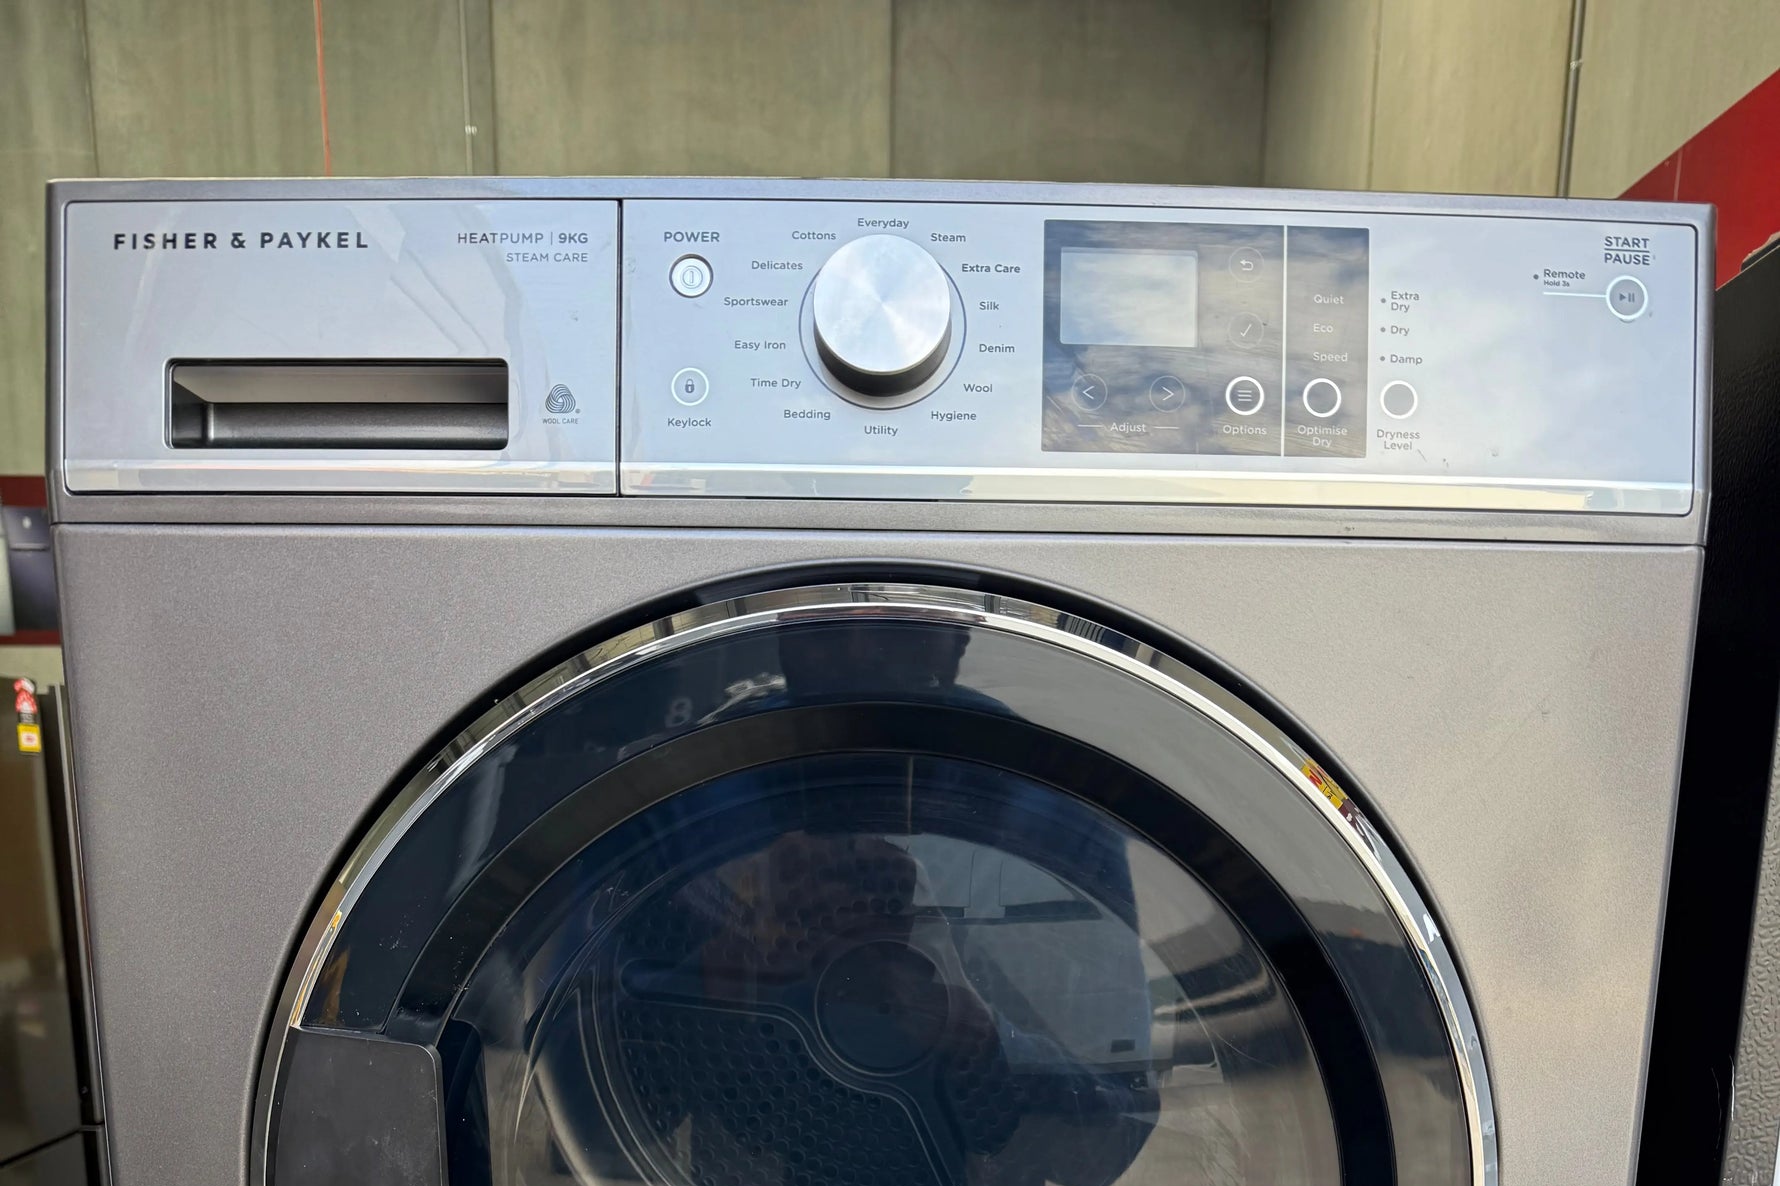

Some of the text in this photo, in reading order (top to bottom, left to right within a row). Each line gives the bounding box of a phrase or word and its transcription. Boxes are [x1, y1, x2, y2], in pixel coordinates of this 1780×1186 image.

[858, 218, 909, 230] Everyday
[113, 232, 369, 250] FISHER & PAYKEL
[457, 233, 589, 245] HEATPUMP 9KG
[664, 231, 720, 242] POWER
[792, 231, 836, 240] Cottons
[930, 233, 966, 243] Steam
[1604, 236, 1650, 249] START
[506, 252, 588, 263] STEAM CARE
[1604, 253, 1650, 265] PAUSE
[751, 260, 803, 270] Delicates
[961, 264, 1021, 274] Extra Care
[1543, 269, 1586, 280] Remote
[1314, 294, 1344, 305] Quiet
[1391, 291, 1419, 301] Extra
[724, 297, 788, 308] Sportswear
[979, 301, 1000, 311] Silk
[1391, 302, 1410, 312] Dry
[1313, 324, 1333, 333] Eco
[1390, 325, 1410, 336] Dry
[734, 340, 786, 352] Easy Iron
[979, 343, 1015, 353] Denim
[1313, 352, 1348, 364] Speed
[1390, 354, 1423, 366] Damp
[751, 378, 801, 390] Time Dry
[963, 383, 993, 393] Wool
[784, 409, 831, 421] Bedding
[930, 411, 976, 422] Hygiene
[667, 417, 712, 429] Keylock
[1110, 422, 1146, 434] Adjust
[864, 425, 898, 436] Utility
[1223, 424, 1267, 437] Options
[1297, 425, 1348, 437] Optimise
[1376, 429, 1420, 441] Dryness
[1312, 437, 1332, 448] Dry
[1384, 440, 1413, 451] Level
